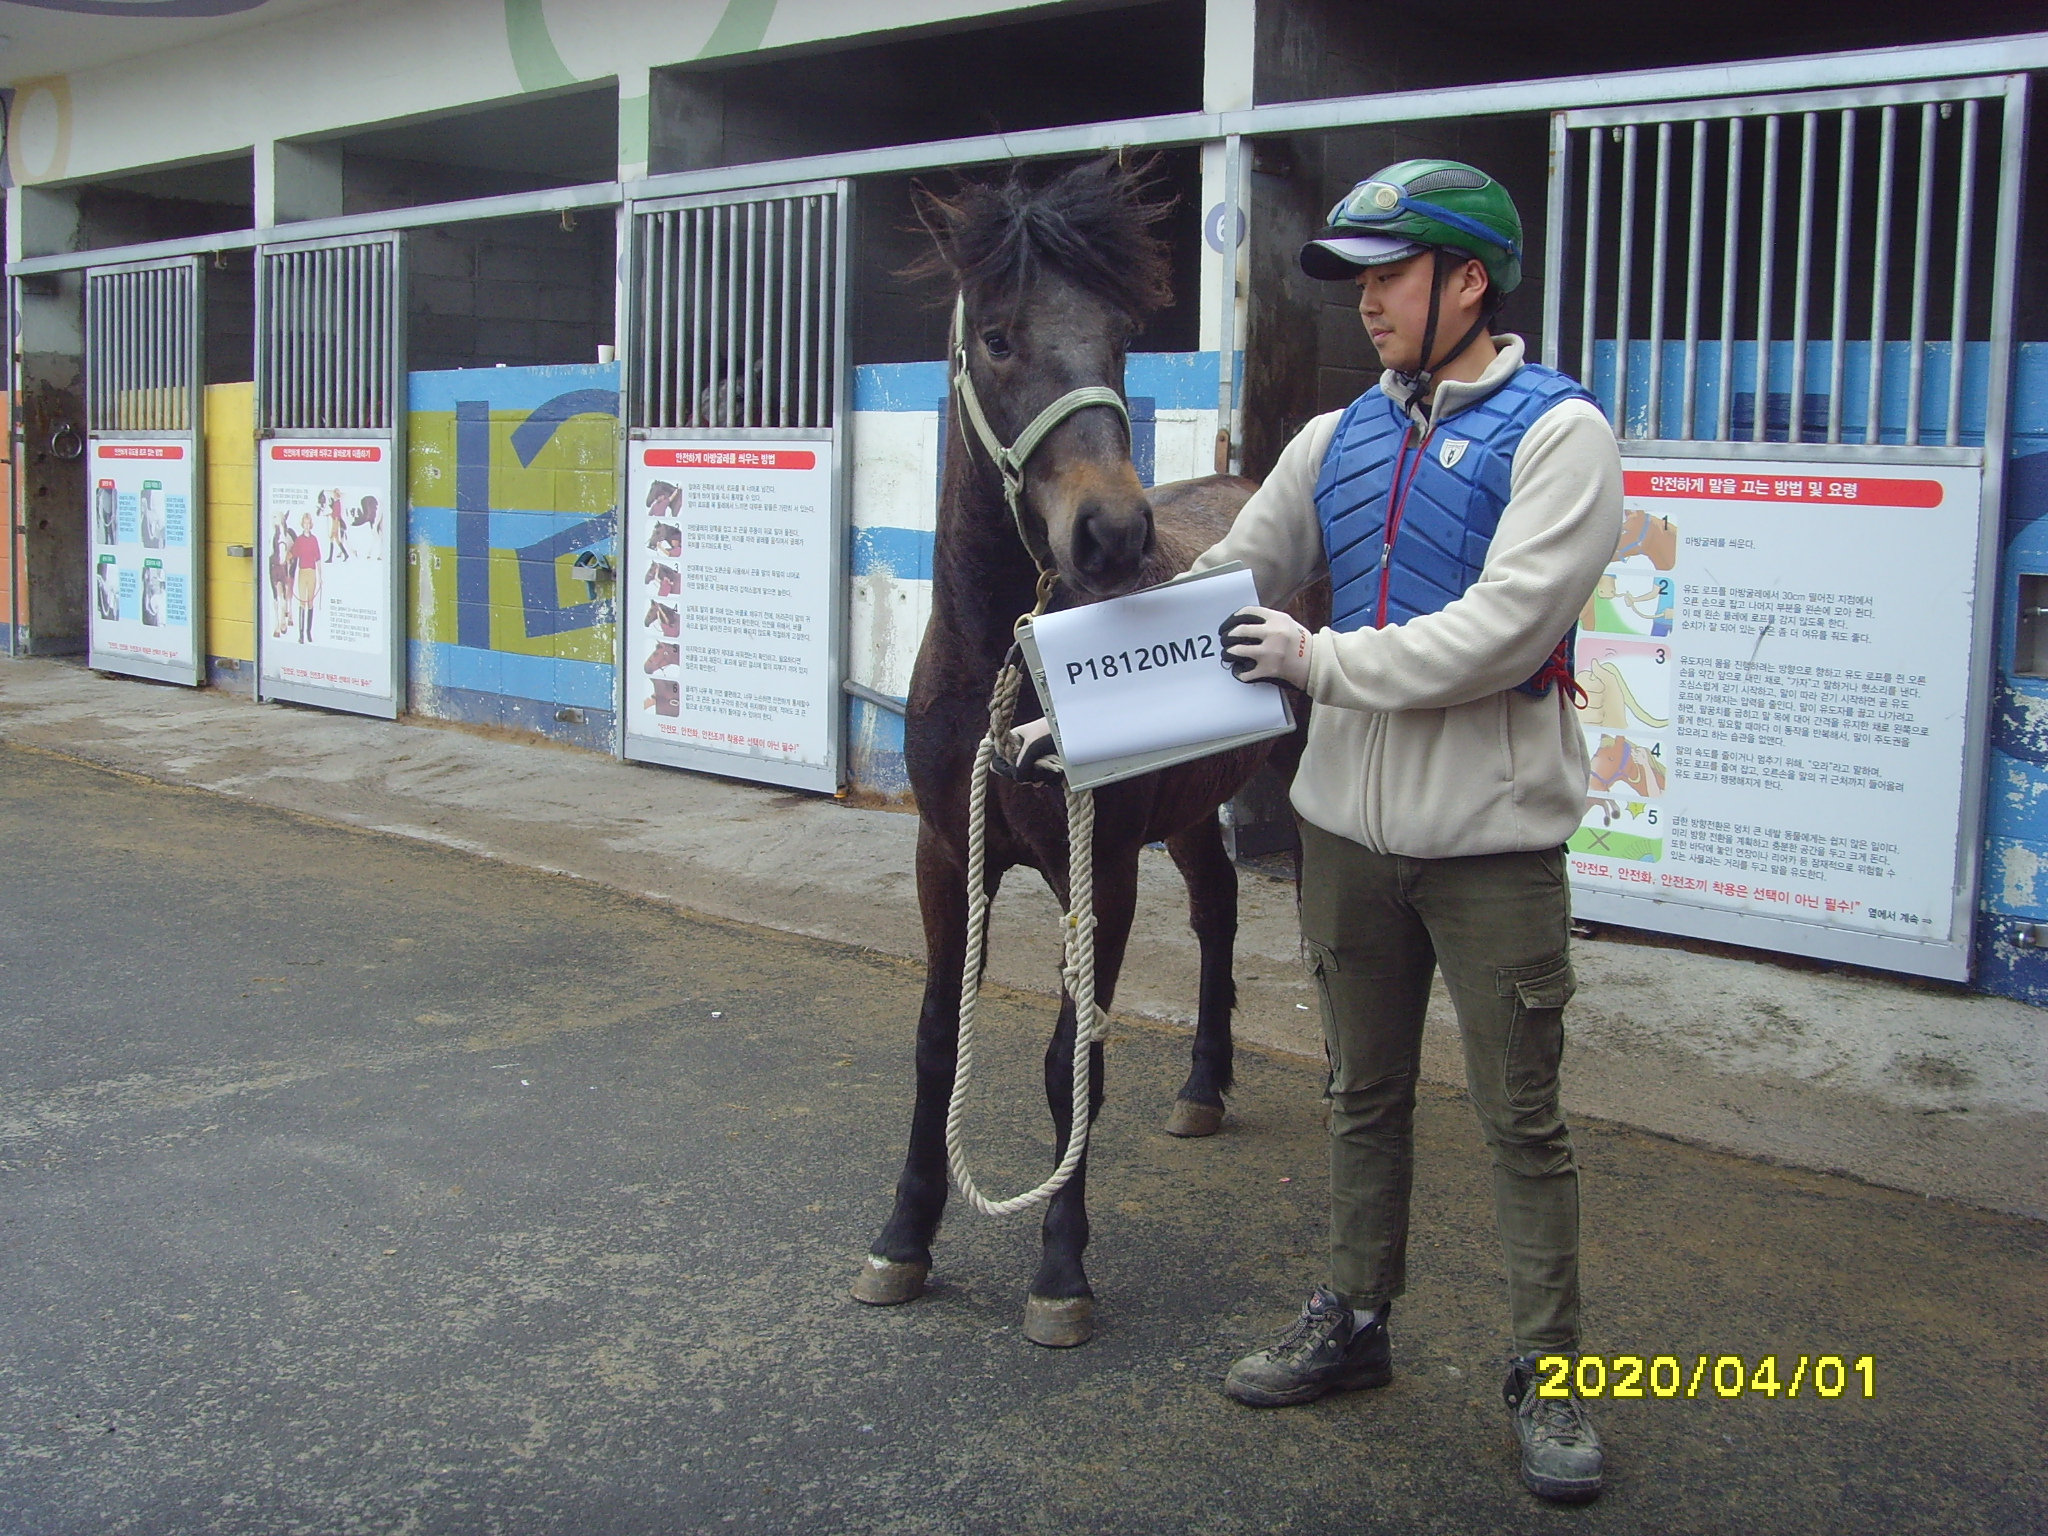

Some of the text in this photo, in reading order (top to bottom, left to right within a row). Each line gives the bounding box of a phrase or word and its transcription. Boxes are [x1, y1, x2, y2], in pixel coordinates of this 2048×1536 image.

[675, 452, 775, 464] 안전하게 마방굴레를 씌우는 방법
[1651, 476, 1856, 498] 안전하게 말을 끄는 방법 및 요령
[1662, 515, 1668, 531] 1
[1685, 536, 1755, 549] 마방굴레를 씌운다.
[674, 563, 679, 572] 3
[1658, 580, 1668, 594] 2
[1683, 584, 1699, 594] 유도
[1729, 587, 1779, 601] 마방굴레에서
[1781, 591, 1805, 601] 30cm
[1808, 592, 1834, 604] 떨어진
[1836, 594, 1872, 606] 지점에서
[1701, 597, 1726, 608] 손으로
[1728, 599, 1746, 610] 잡고
[1748, 600, 1773, 612] 나머지
[1775, 602, 1802, 615] 부분을
[1804, 604, 1831, 616] 왼손에
[1833, 606, 1852, 617] 모아
[1682, 608, 1690, 618] 이
[1692, 608, 1701, 618] 때
[1798, 616, 1825, 628] 않도록
[1827, 618, 1848, 629] 한다.
[1066, 634, 1216, 685] P18120M2
[1656, 649, 1665, 664] 3
[1679, 655, 1712, 667] 유도자의
[1714, 658, 1731, 669] 몸을
[1778, 663, 1813, 676] 방향으로
[1815, 666, 1842, 679] 향하고
[1843, 669, 1863, 680] 유도
[673, 684, 677, 693] 6
[1679, 667, 1696, 678] 손을
[1698, 668, 1714, 679] 약간
[1717, 670, 1742, 682] 앞으로
[1822, 679, 1858, 692] 말하거나
[1899, 686, 1920, 698] 낸다.
[1678, 679, 1718, 692] 조심스럽게
[1779, 688, 1796, 699] 말이
[1799, 690, 1817, 701] 따라
[1840, 693, 1876, 706] 시작하면
[1878, 697, 1888, 707] 곧
[1890, 698, 1909, 711] 유도
[1677, 690, 1702, 703] 로프에
[1705, 693, 1739, 706] 가해지는
[1767, 699, 1796, 711] 줄인다.
[1799, 702, 1816, 713] 말이
[1818, 704, 1854, 718] 유도자를
[1878, 709, 1914, 723] 나가려고
[1699, 704, 1731, 717] 팔꿈치를
[1761, 710, 1771, 721] 말
[1772, 712, 1790, 723] 목에
[1793, 713, 1810, 725] 대어
[1813, 715, 1839, 728] 간격을
[1841, 718, 1869, 731] 유지한
[1871, 721, 1890, 733] 채로
[1892, 723, 1929, 737] 왼쪽으로
[747, 736, 764, 748] 선택이
[766, 740, 779, 750] 아닌
[1676, 726, 1785, 747] 잡으려고 하는 습관을 없앤다.
[1651, 743, 1661, 757] 4
[1675, 745, 1691, 756] 말의
[1694, 747, 1718, 759] 속도를
[1721, 750, 1754, 763] 줄이거나
[1674, 768, 1691, 779] 유도
[1692, 770, 1717, 782] 로프가
[1763, 779, 1783, 790] 한다.
[1648, 809, 1658, 825] 5
[1671, 815, 1688, 826] 급한
[1690, 817, 1731, 832] 방향전환은
[1752, 826, 1761, 836] 큰
[1784, 830, 1827, 845] 동물에게는
[1829, 836, 1847, 847] 쉽지
[1849, 838, 1868, 850] 않은
[1870, 841, 1899, 854] 일이다.
[1670, 838, 1687, 850] 또한
[1689, 841, 1713, 853] 바닥에
[1798, 856, 1808, 867] 등
[1856, 863, 1883, 877] 위험할
[1886, 868, 1895, 878] 수
[1617, 866, 1656, 885] 안전화,
[1660, 873, 1708, 892] 안전조끼
[1712, 880, 1748, 898] 착용은
[1752, 886, 1789, 904] 선택이
[1794, 892, 1819, 909] 아닌
[1868, 907, 1918, 924] 옆에서 계속
